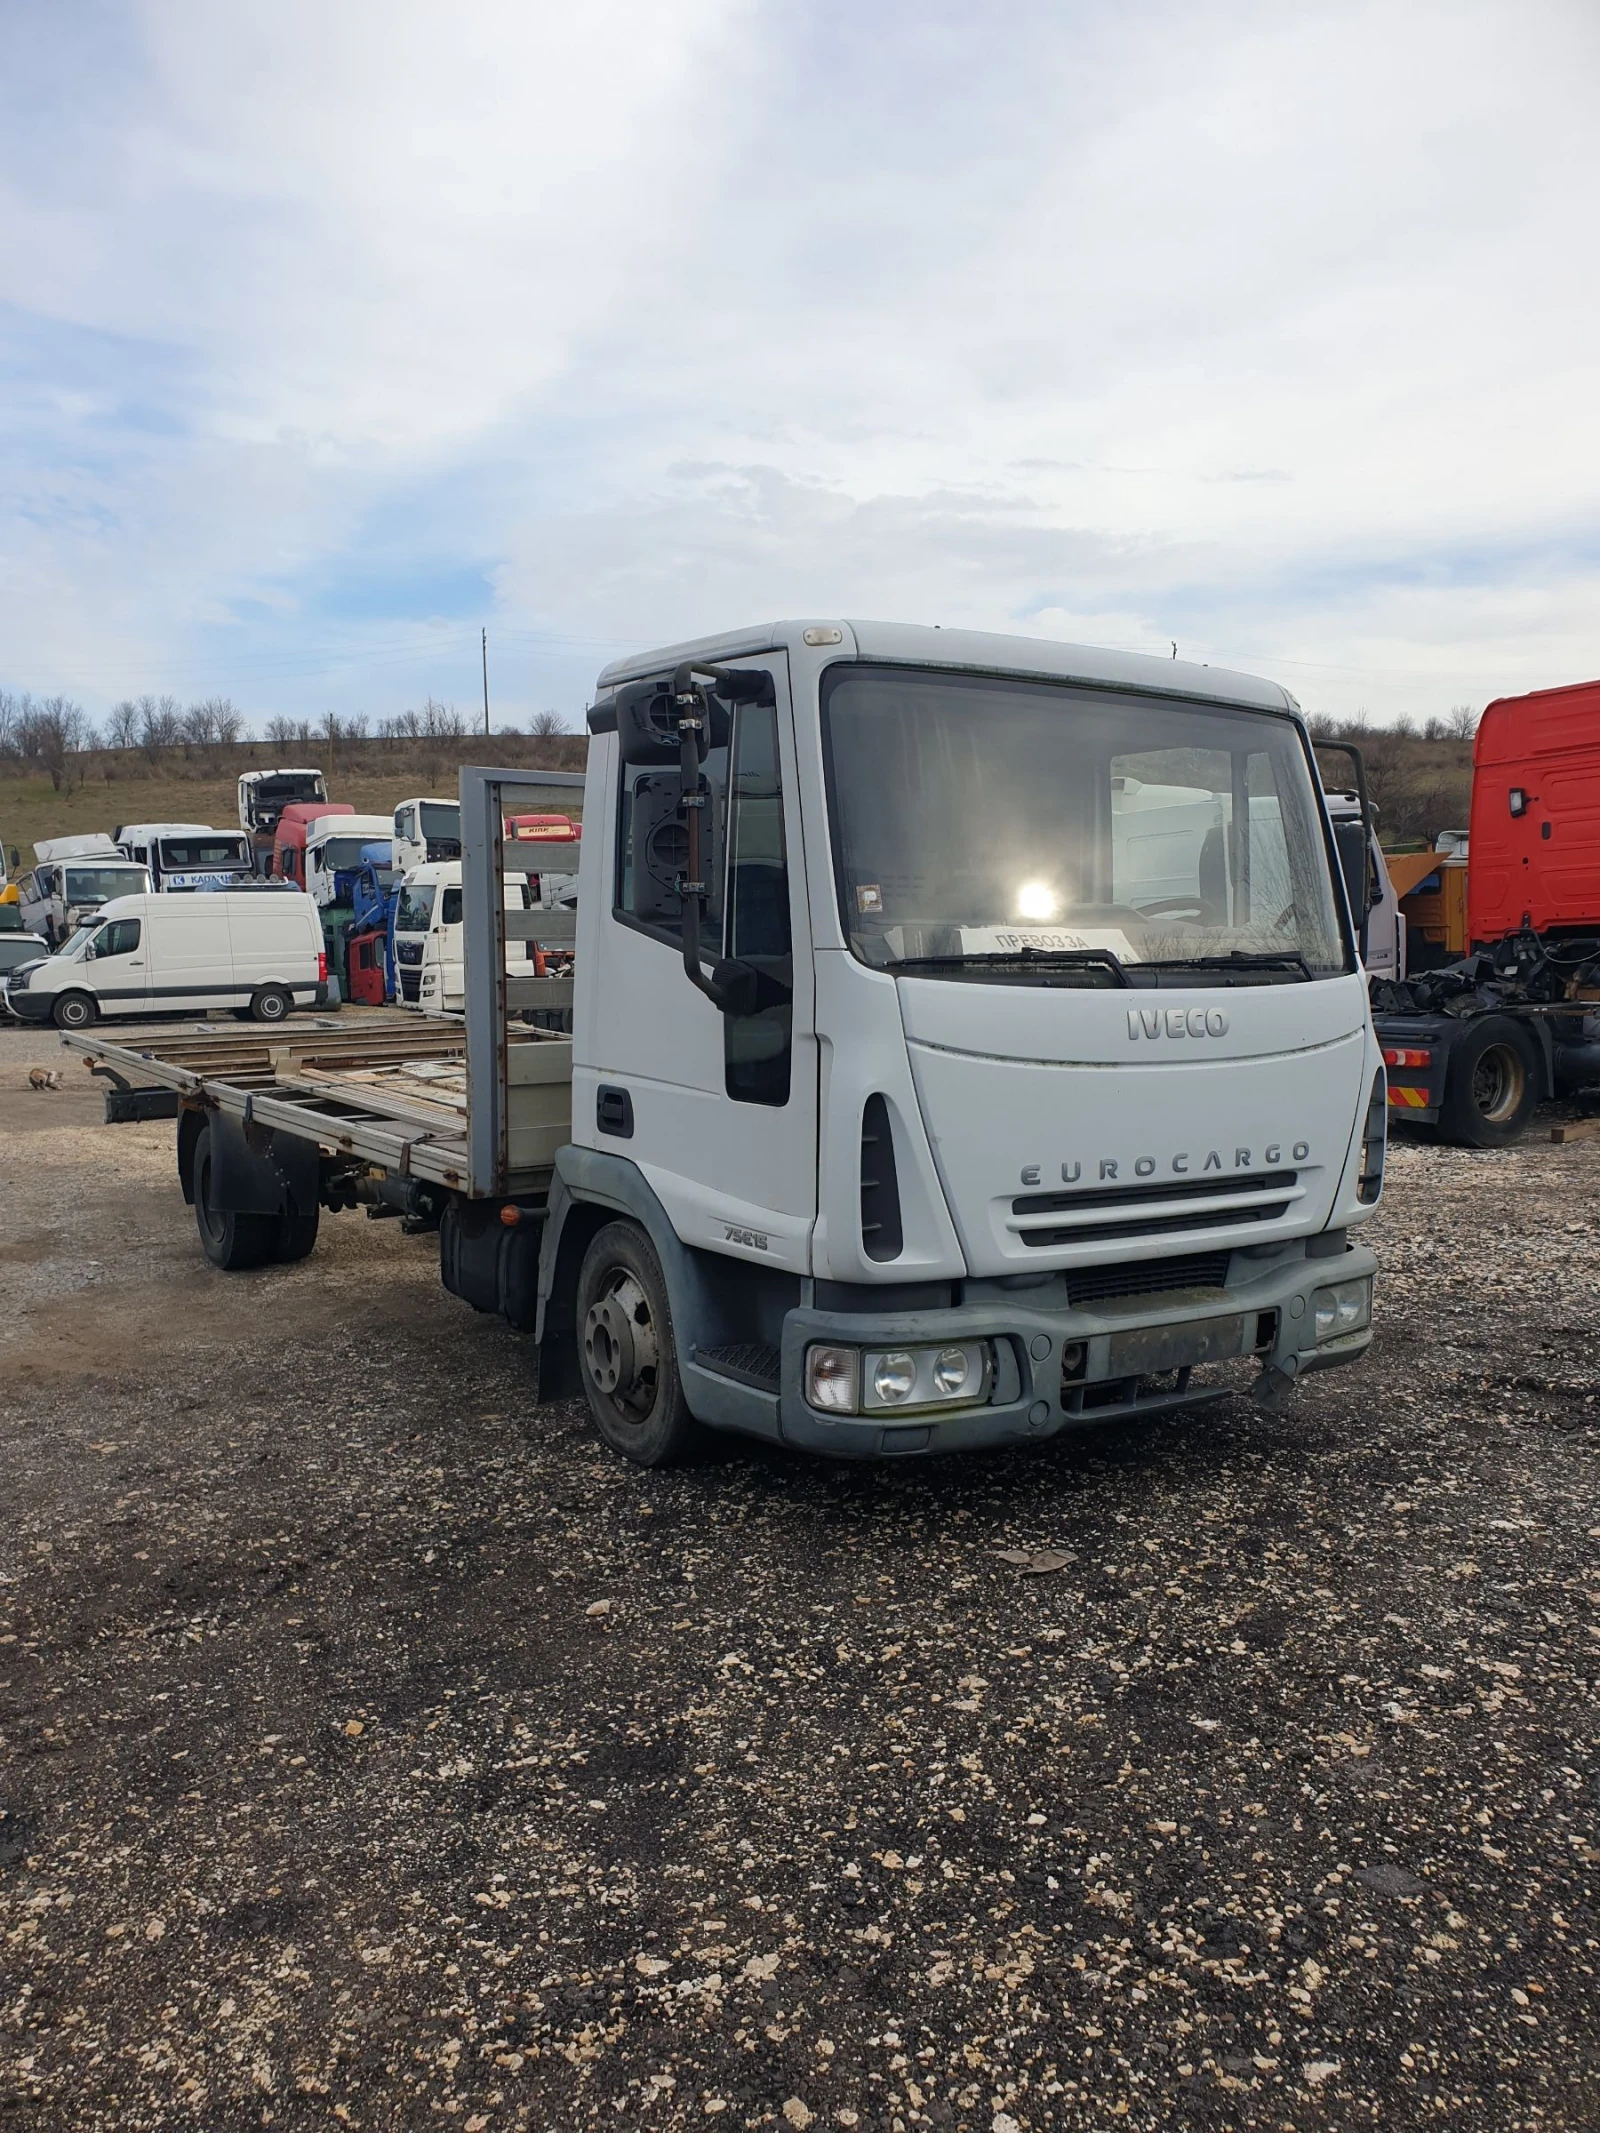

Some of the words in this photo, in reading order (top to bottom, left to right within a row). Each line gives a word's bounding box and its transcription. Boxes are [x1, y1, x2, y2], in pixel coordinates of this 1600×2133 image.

[995, 934, 1062, 948] ПРЕВОЗ
[1064, 935, 1089, 949] ЗА
[1126, 1007, 1230, 1041] IVECO
[1020, 1140, 1310, 1186] EUROCARGO
[724, 1225, 768, 1251] 75E15
